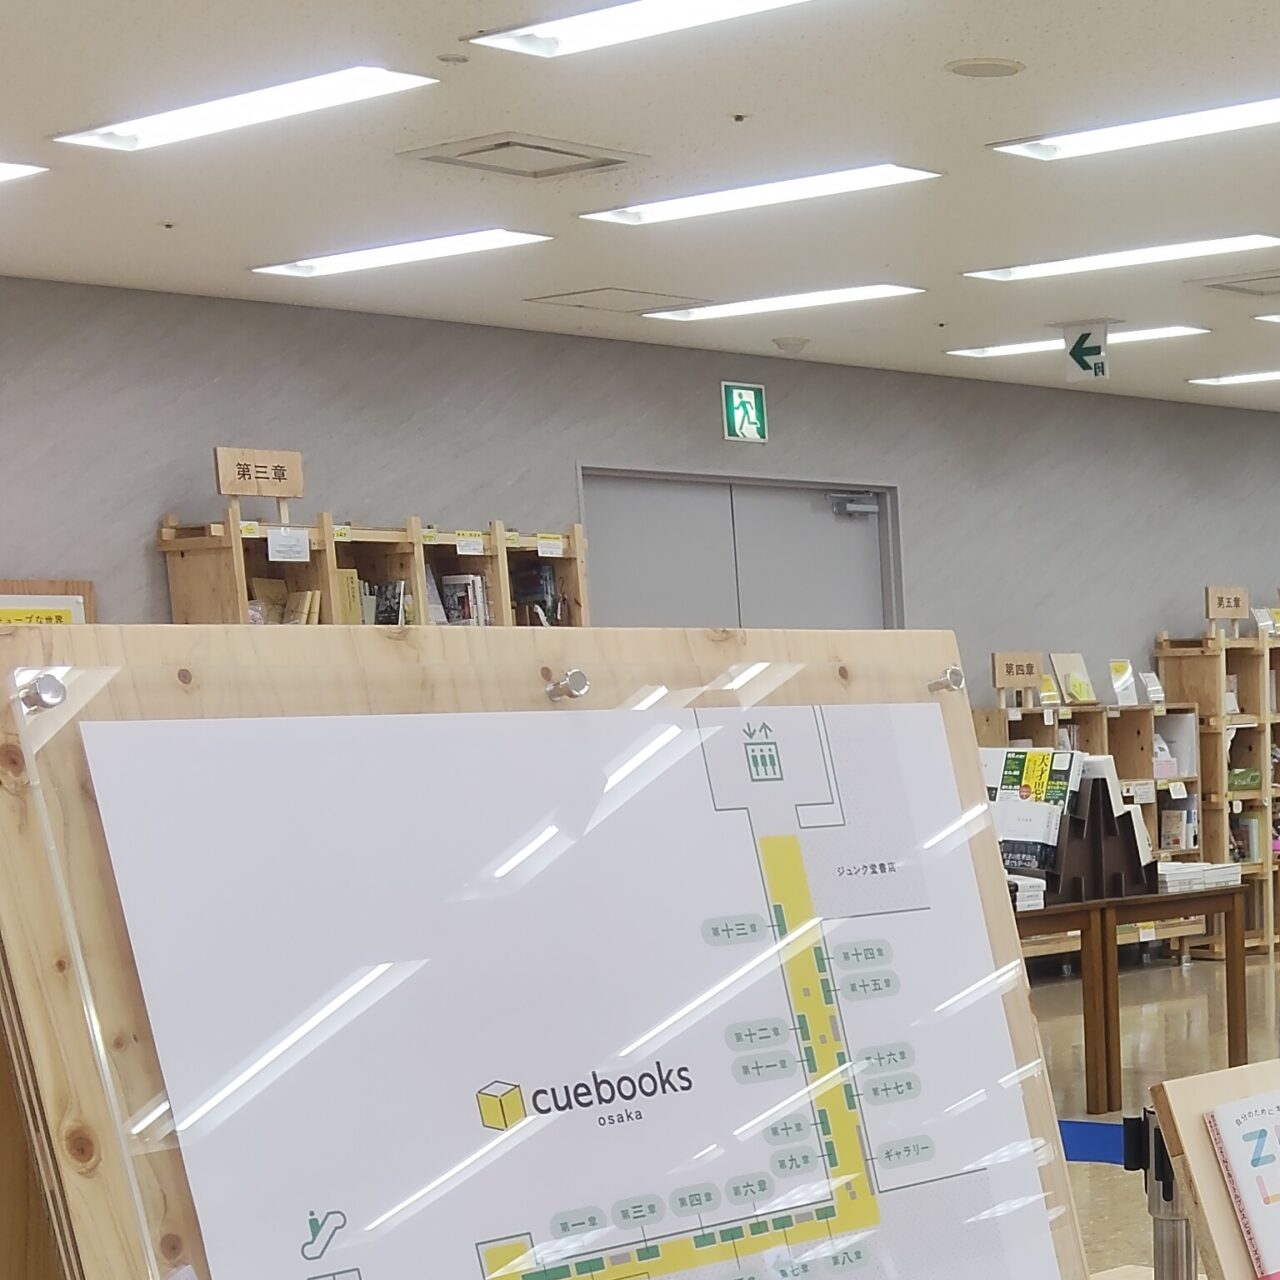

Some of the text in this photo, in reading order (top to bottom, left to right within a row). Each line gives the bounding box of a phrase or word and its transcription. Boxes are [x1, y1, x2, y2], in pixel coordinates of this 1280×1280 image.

[235, 461, 288, 483] 第三章
[1216, 596, 1241, 609] 第五章
[1005, 662, 1035, 677] 第四章
[836, 862, 897, 877] ジュンク堂書店
[711, 922, 757, 939] 第十三章
[843, 947, 885, 963] 第十四章
[850, 978, 892, 994] 第十五章
[734, 1026, 781, 1044] 第十二章
[741, 1059, 788, 1076] 第十一章
[531, 1061, 694, 1115] cuebooks
[872, 1081, 913, 1098] 第十七章
[597, 1108, 643, 1127] osaka
[771, 1121, 804, 1138] 第十章
[884, 1143, 930, 1162] ギャラリー
[778, 1154, 810, 1170] 第九章
[732, 1179, 768, 1197] 第六章
[678, 1190, 714, 1209] 第四章
[620, 1203, 657, 1222] 第三章
[560, 1215, 599, 1233] 第一章
[831, 1250, 863, 1266] 第八章
